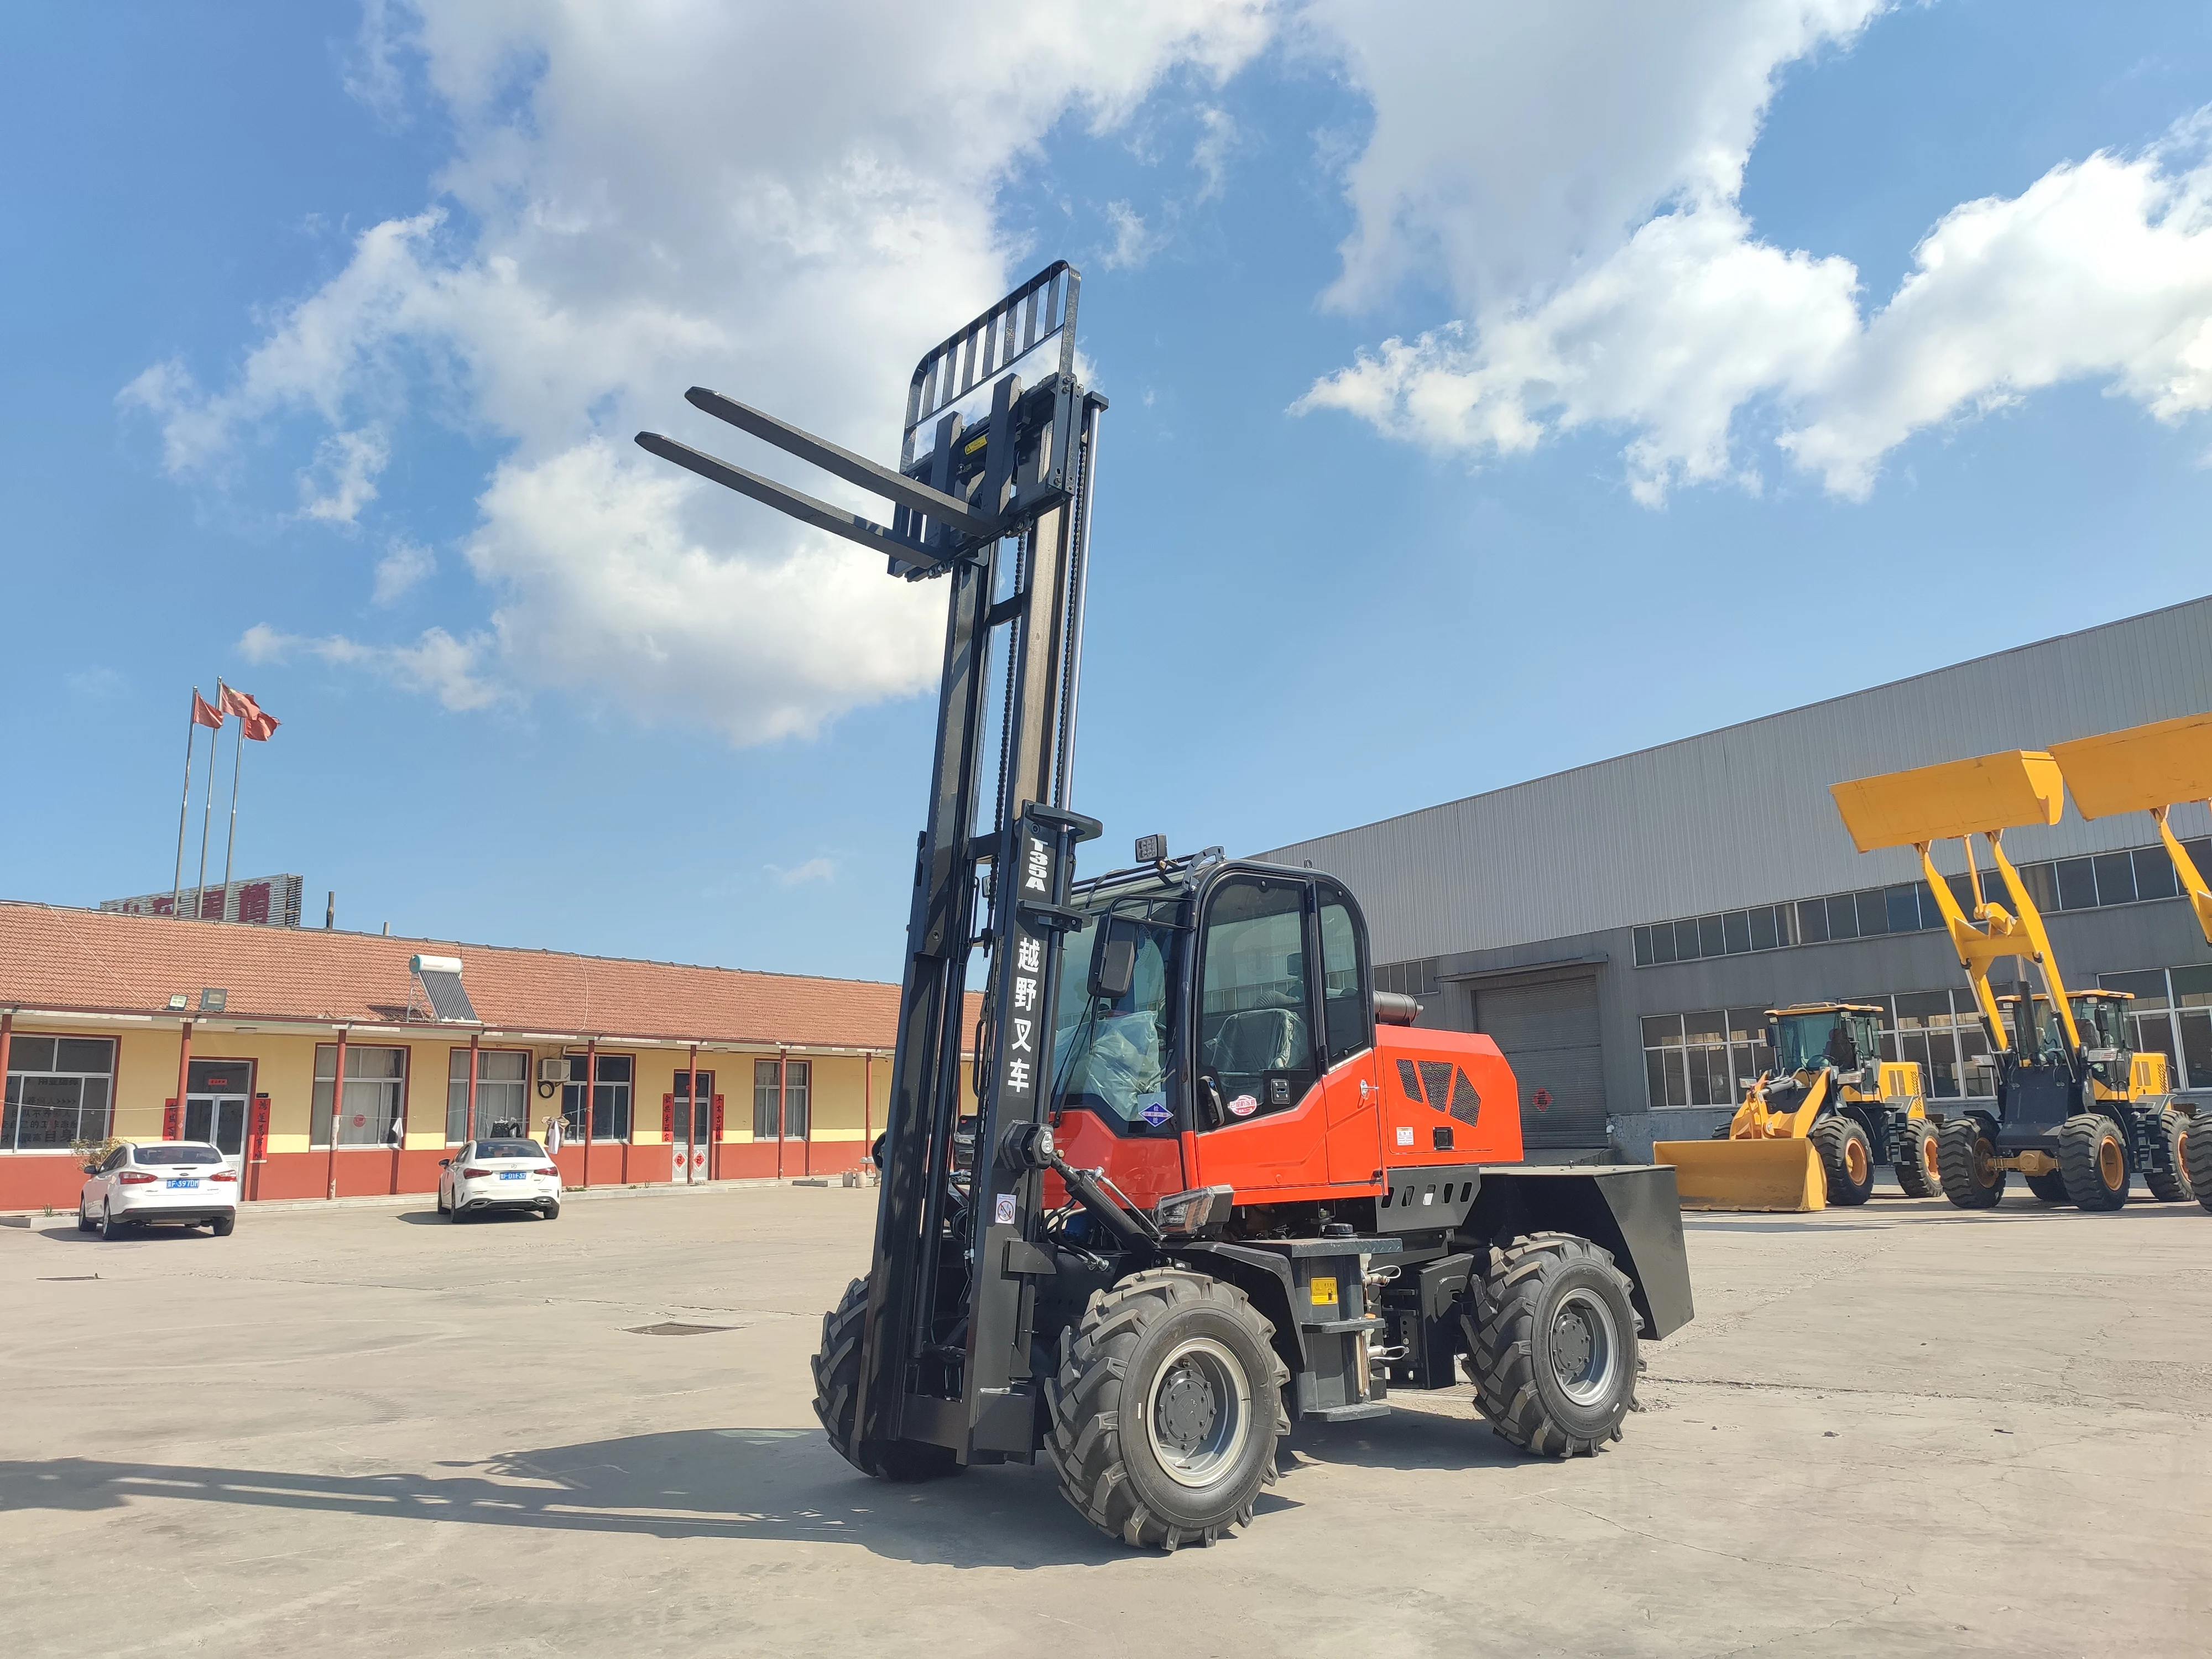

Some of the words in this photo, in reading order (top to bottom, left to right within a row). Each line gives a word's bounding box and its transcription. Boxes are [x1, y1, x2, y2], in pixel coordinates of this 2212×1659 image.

[1025, 837, 1048, 892] T35A
[1008, 937, 1040, 1093] 越野叉车
